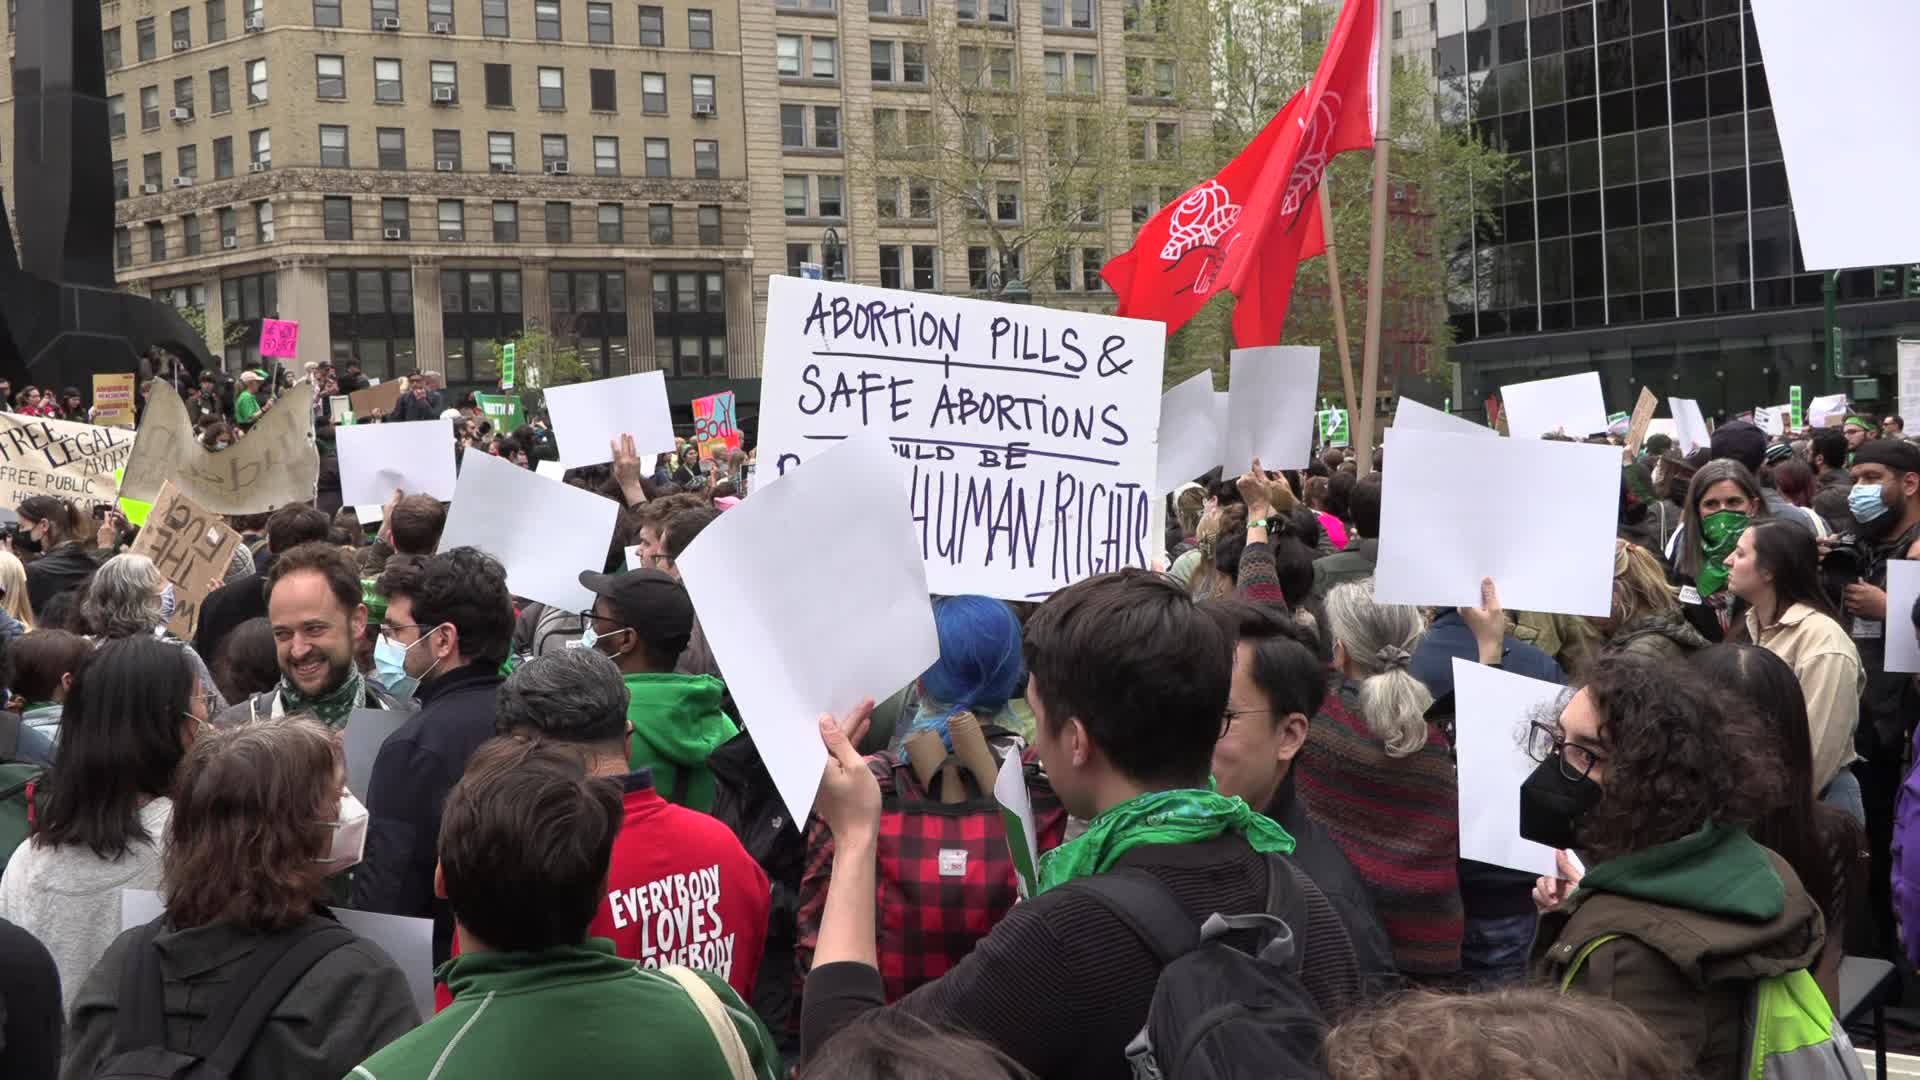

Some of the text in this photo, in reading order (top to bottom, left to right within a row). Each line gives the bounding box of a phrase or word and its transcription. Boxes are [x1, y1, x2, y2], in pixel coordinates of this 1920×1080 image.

[990, 316, 1087, 372] PILLS
[1097, 335, 1133, 377] &
[799, 364, 914, 426] SAFE
[0, 466, 95, 494] FREE PUBLIC
[84, 445, 131, 477] ABORT
[891, 442, 1031, 470] ULD BE
[910, 464, 1149, 584] HUMAN RIGHTS
[608, 864, 720, 929] EVERYBODY
[641, 897, 723, 957] LOVES
[643, 933, 735, 974] OMEBODY
